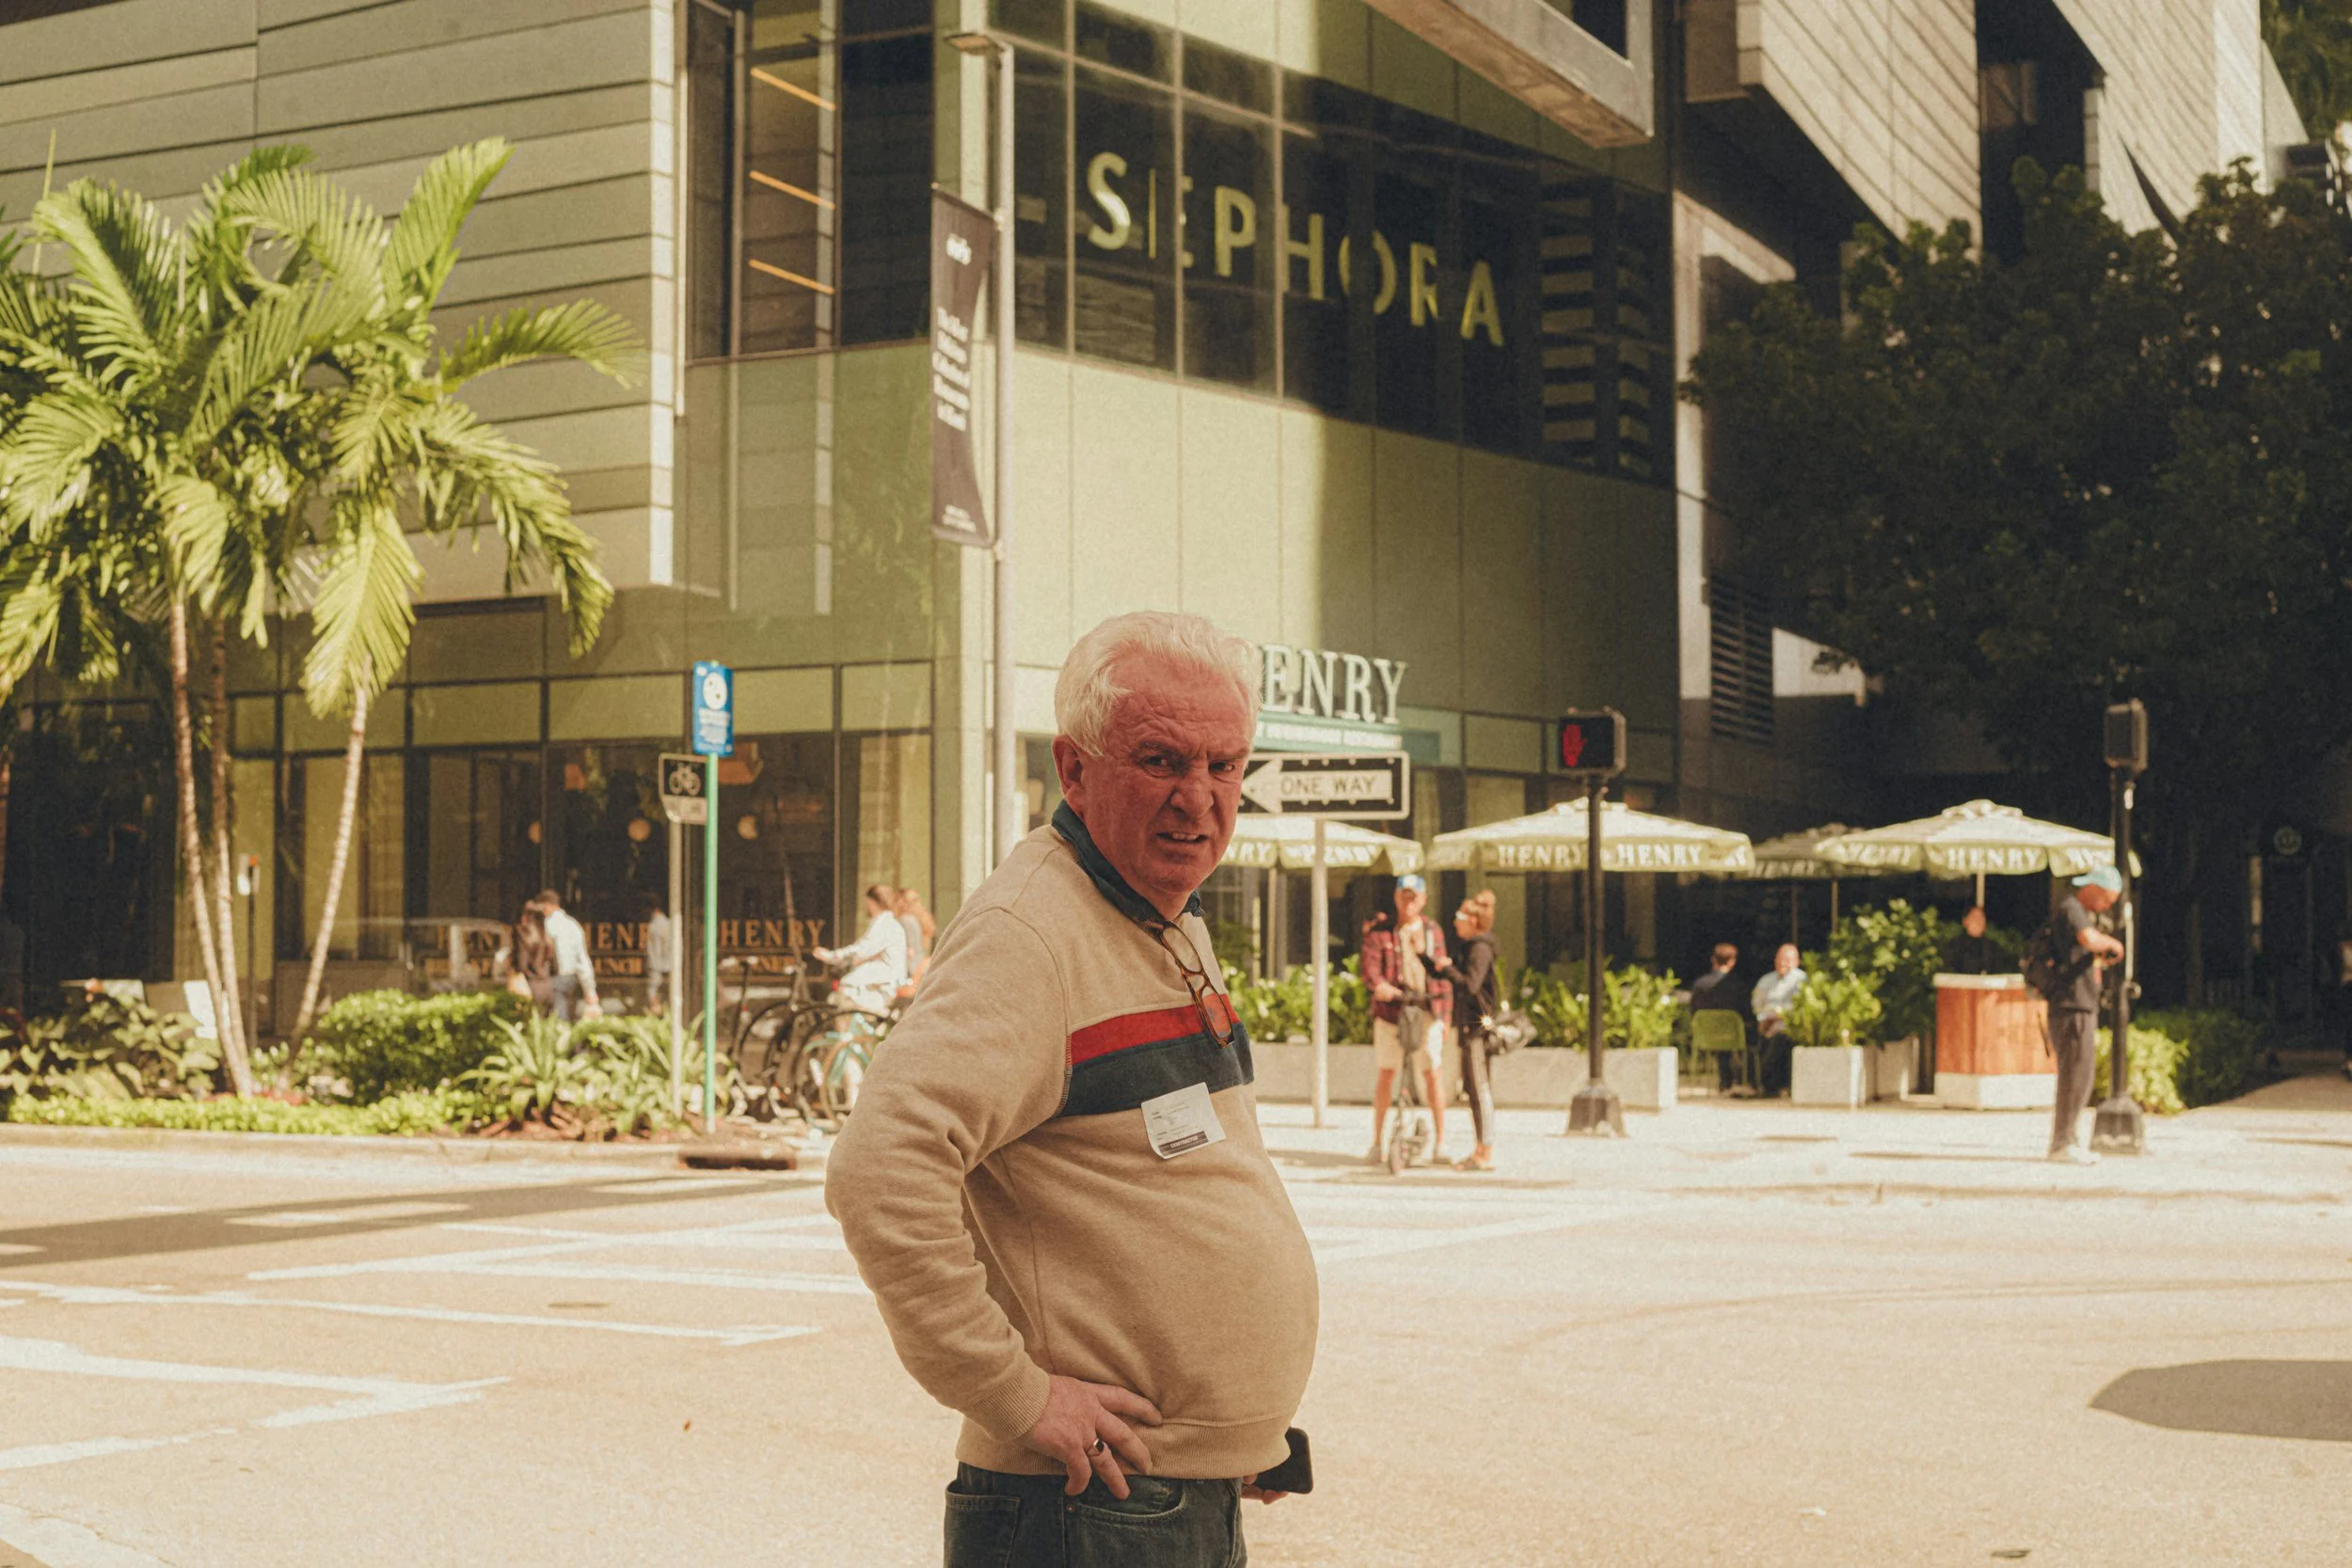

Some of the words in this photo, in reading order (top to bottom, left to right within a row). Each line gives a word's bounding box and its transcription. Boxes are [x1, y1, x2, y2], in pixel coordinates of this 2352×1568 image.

[1262, 644, 1407, 724] ENRY
[1280, 775, 1323, 795] ONE
[1333, 774, 1376, 794] WAY
[1225, 841, 1270, 863] NRY
[1498, 844, 1582, 867] HENRY
[1616, 843, 1702, 867] HENRY
[1947, 847, 2042, 870] HENRY
[721, 918, 824, 948] HENRY
